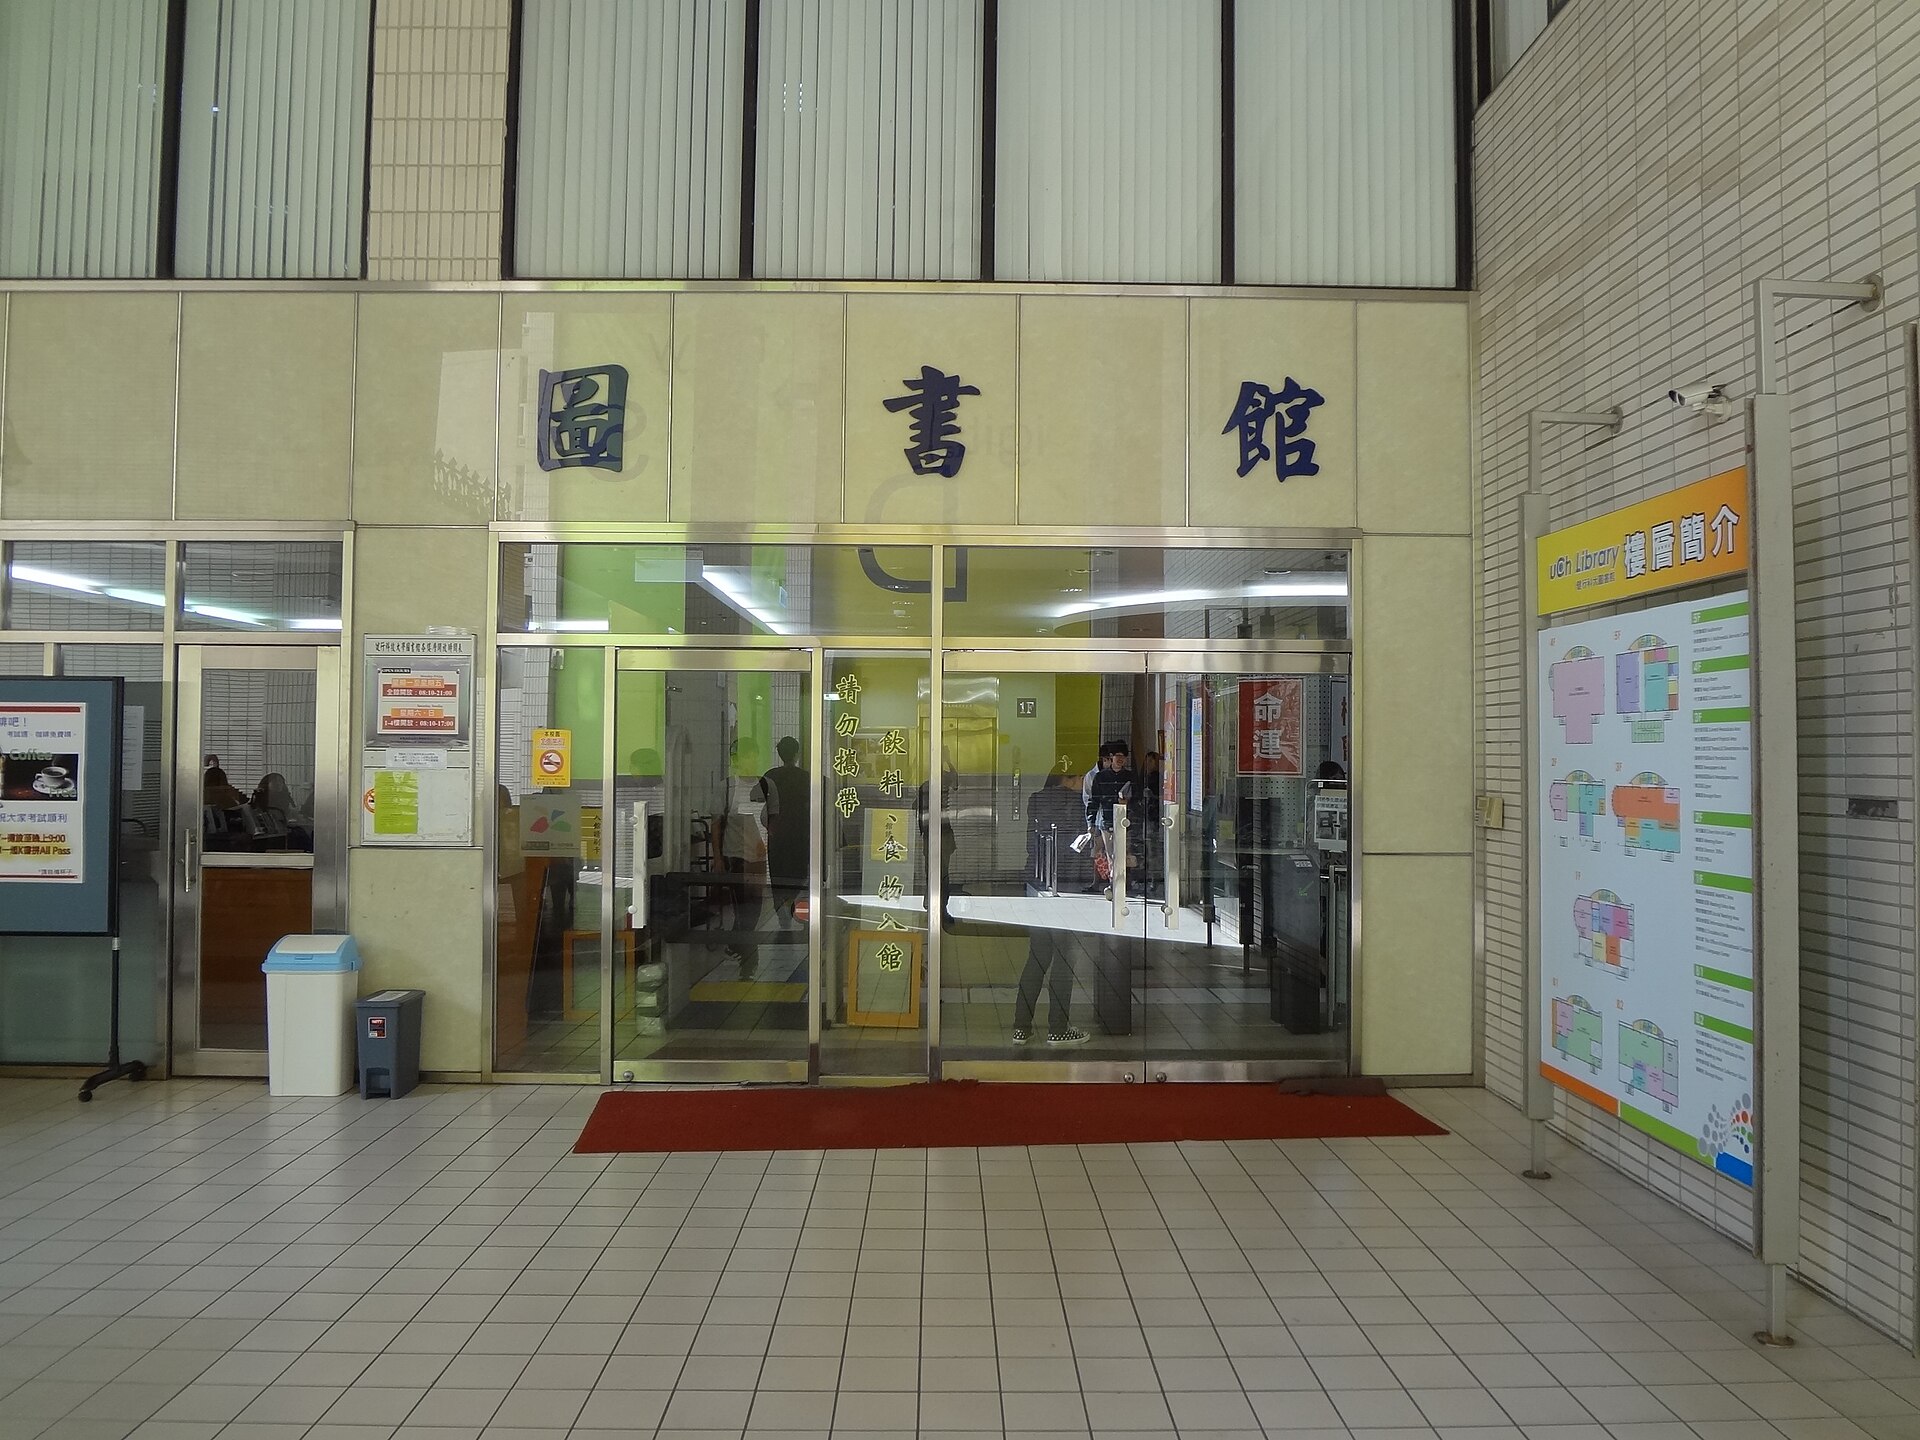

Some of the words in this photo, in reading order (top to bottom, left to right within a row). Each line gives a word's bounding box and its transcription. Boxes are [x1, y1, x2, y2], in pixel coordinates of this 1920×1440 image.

[537, 364, 1325, 482] 圖書館
[1576, 545, 1620, 572] Library
[1623, 504, 1740, 579] 樓層簡介
[1019, 701, 1035, 714] 1F
[1253, 692, 1283, 759] 命運
[9, 748, 53, 761] Coffee
[834, 674, 861, 818] 請勿攜帶
[49, 786, 77, 798] Free
[53, 846, 71, 855] Pass
[876, 730, 908, 972] 飲料、食物入館
